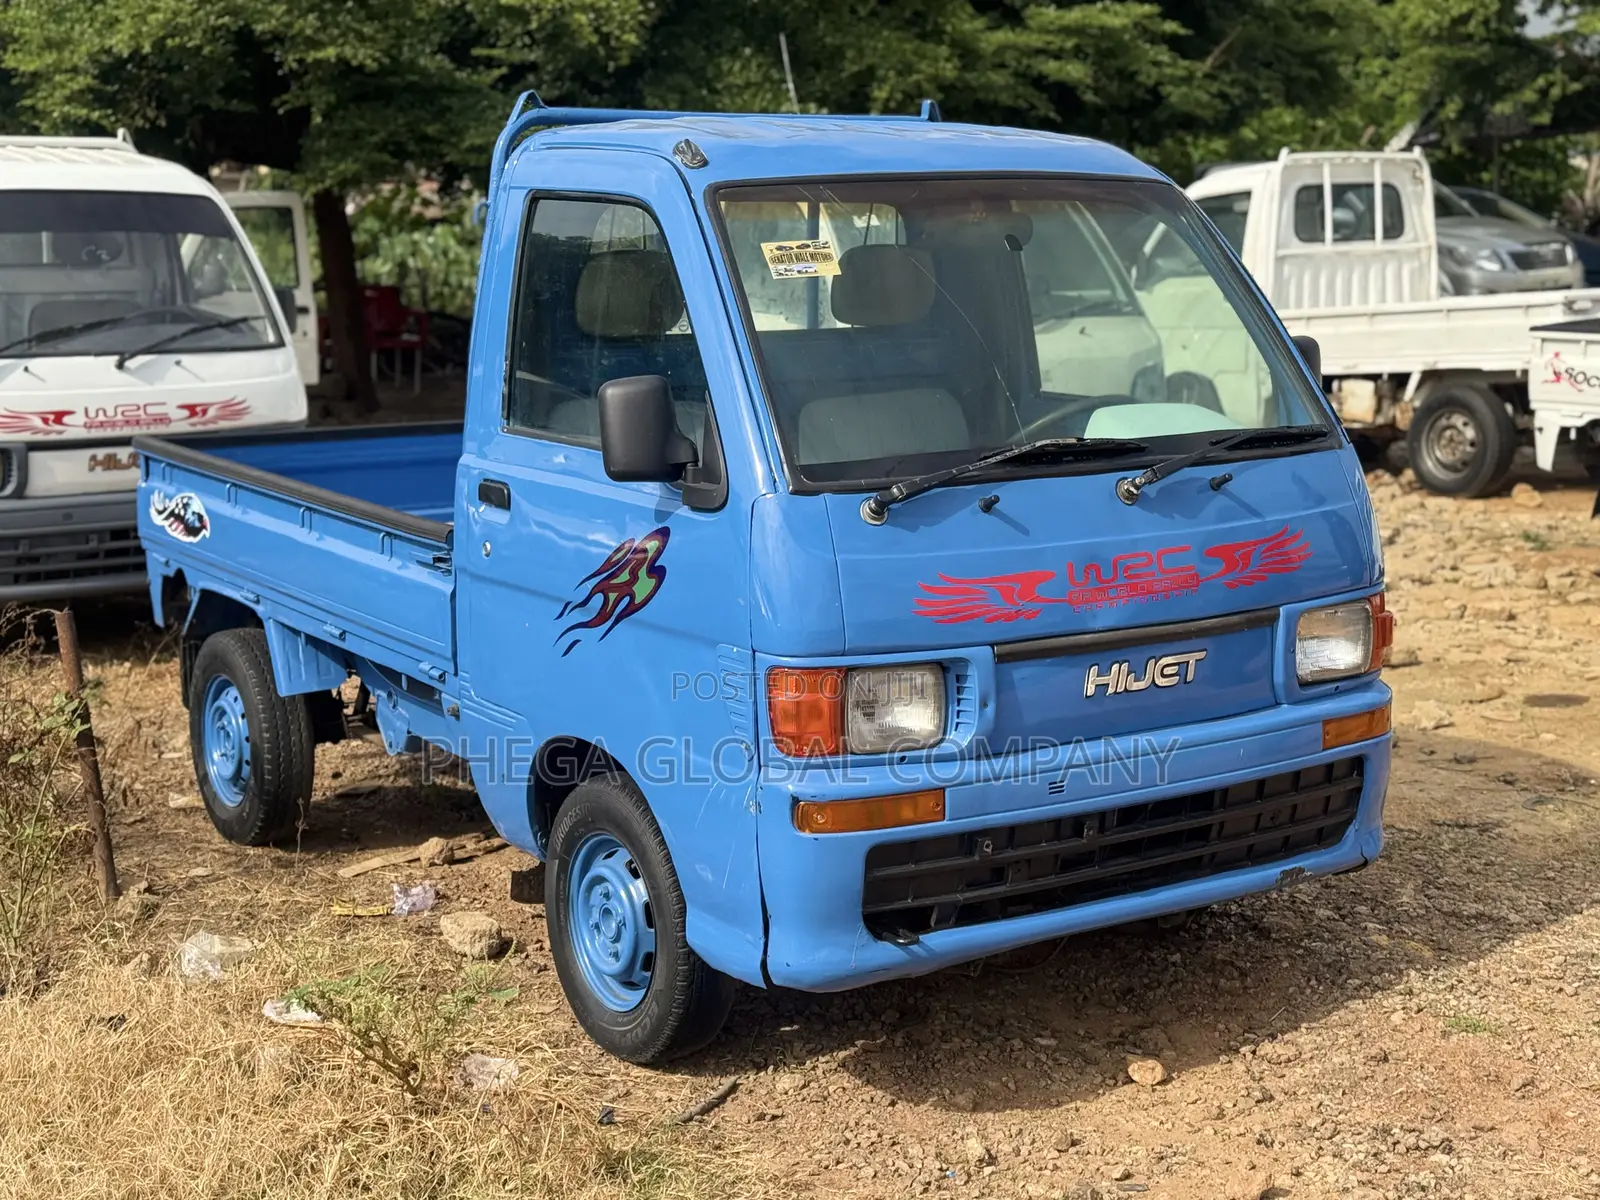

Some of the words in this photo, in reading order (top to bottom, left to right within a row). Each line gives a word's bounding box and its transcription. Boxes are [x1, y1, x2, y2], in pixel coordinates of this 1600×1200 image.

[770, 252, 793, 264] SENATOR
[793, 252, 810, 262] WALE
[809, 251, 832, 263] MOTORS
[1565, 367, 1600, 388] SOC
[84, 402, 168, 420] WRC
[1066, 545, 1196, 587] WRC
[1084, 648, 1208, 699] HIJET
